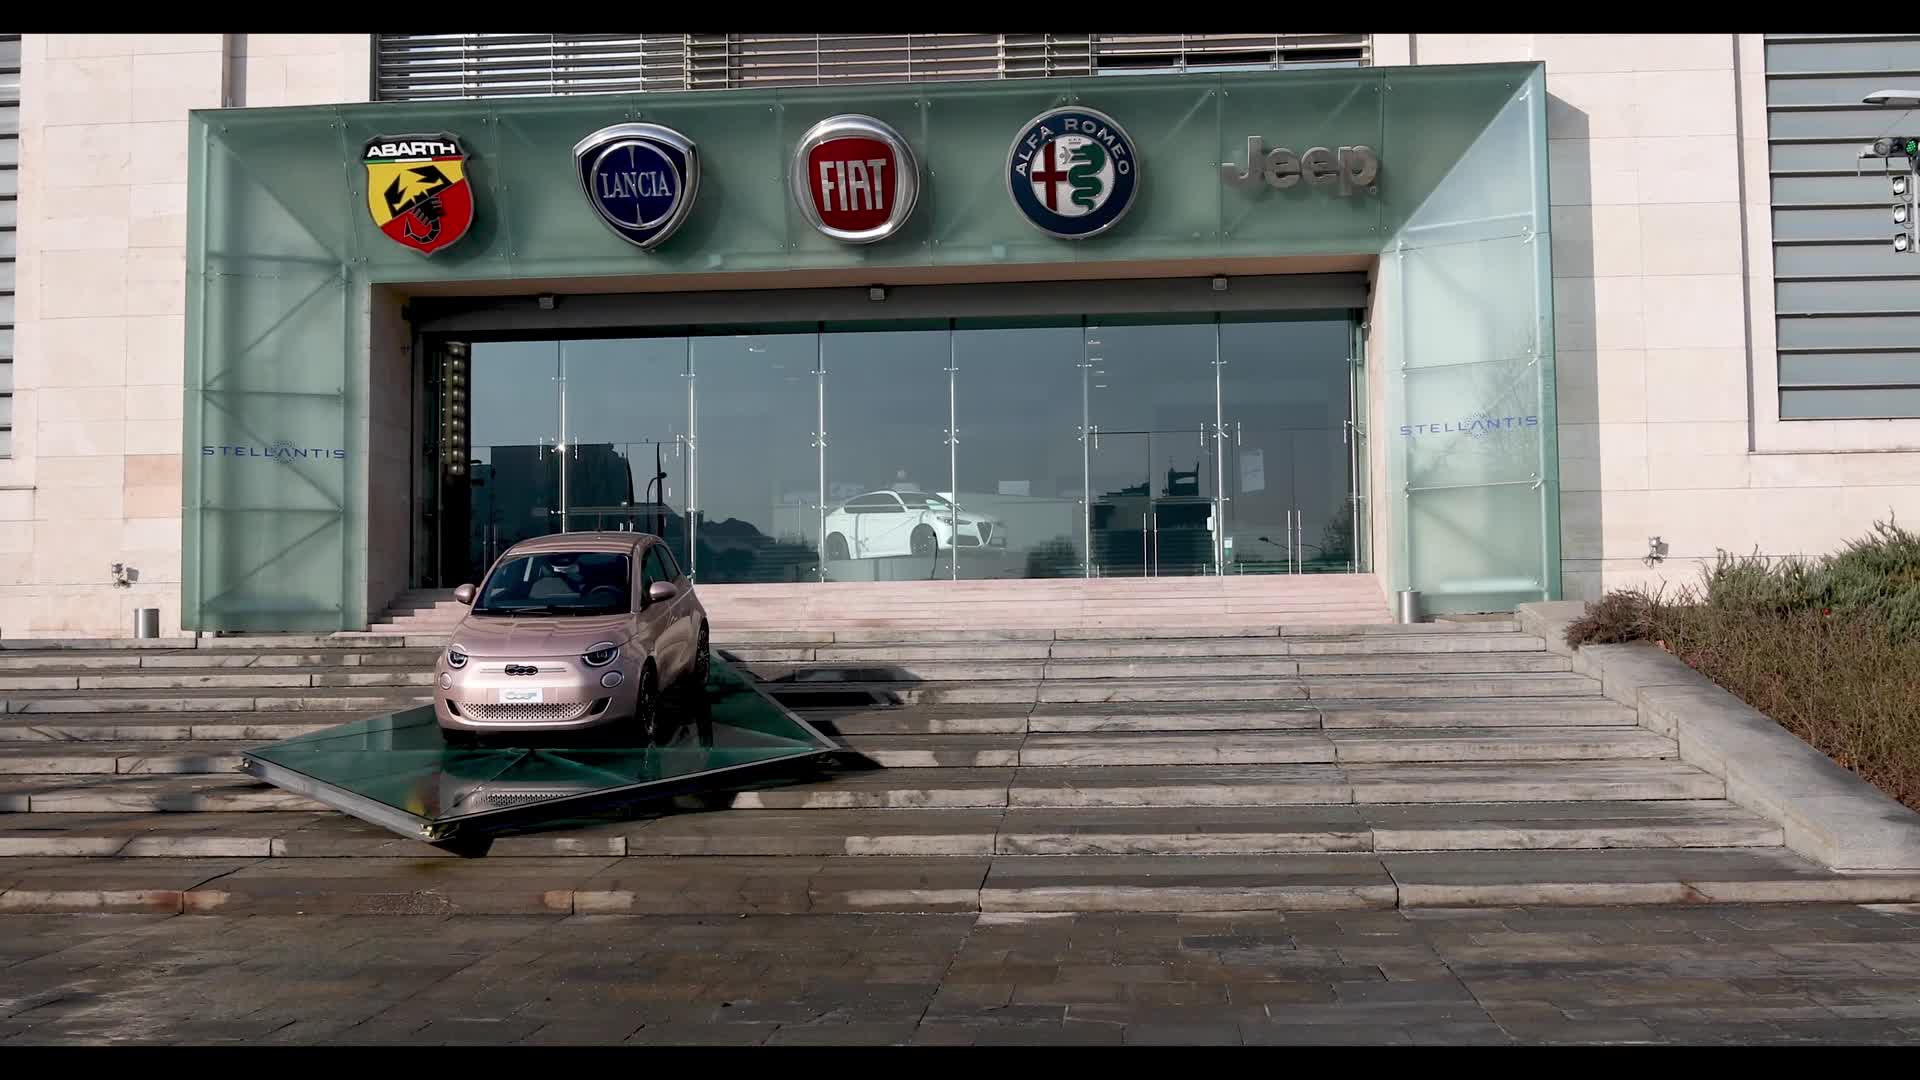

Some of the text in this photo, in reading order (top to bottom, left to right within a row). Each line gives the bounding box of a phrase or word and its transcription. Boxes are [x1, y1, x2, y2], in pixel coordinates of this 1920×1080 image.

[366, 141, 456, 158] ABARTH
[1016, 118, 1130, 177] ALFA ROMEO
[1219, 135, 1377, 196] Jeep
[600, 170, 673, 200] LANCIA
[819, 158, 887, 212] FIAT
[1400, 415, 1538, 436] STELLANTIS
[202, 446, 345, 459] STELLANTIS
